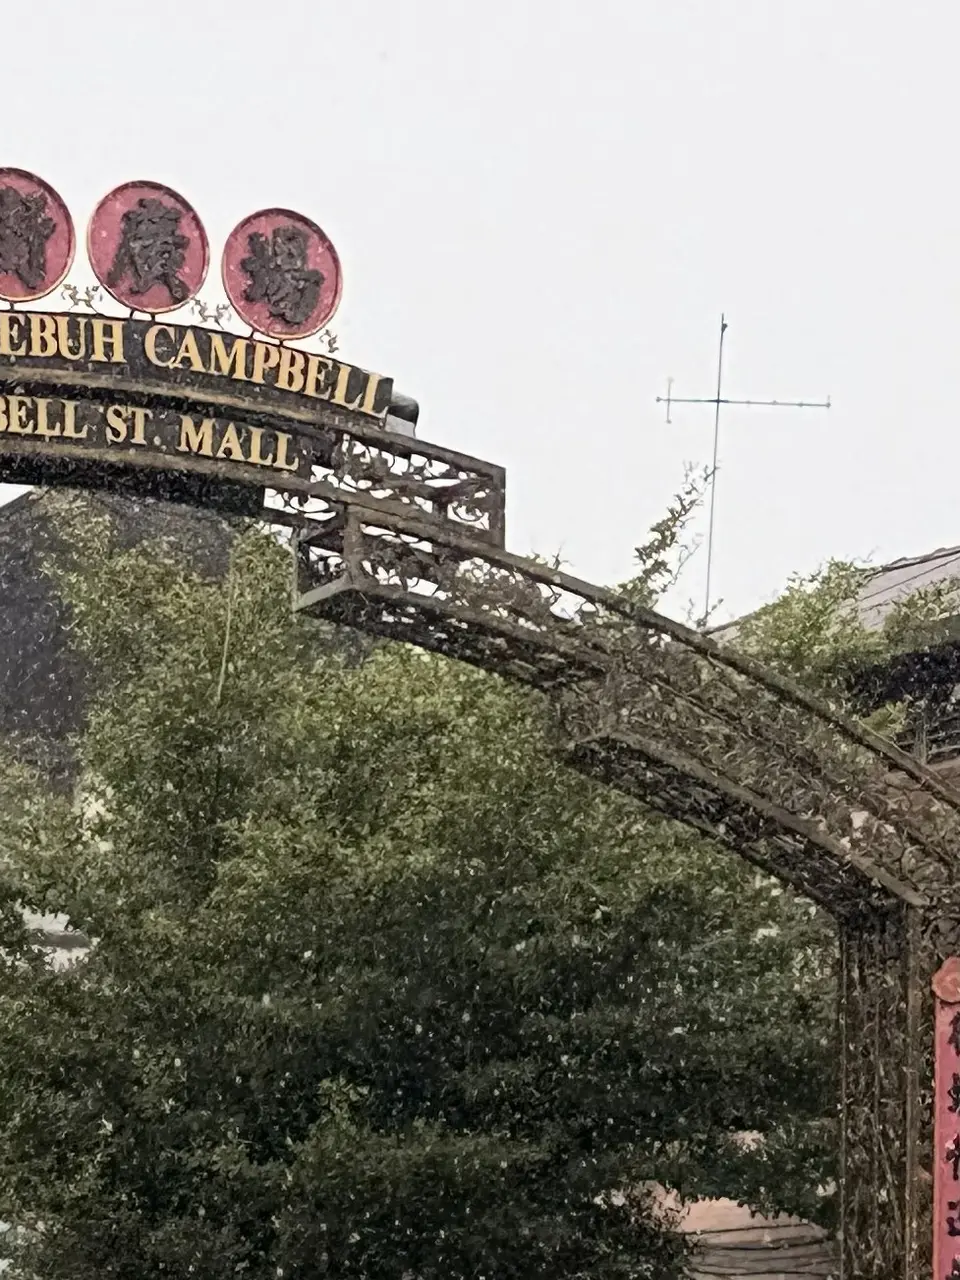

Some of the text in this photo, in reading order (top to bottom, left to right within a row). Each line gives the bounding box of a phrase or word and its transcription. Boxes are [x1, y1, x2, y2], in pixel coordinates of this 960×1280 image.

[144, 324, 390, 418] CAMPBELL
[105, 404, 162, 446] ST.
[177, 414, 300, 471] MALL
